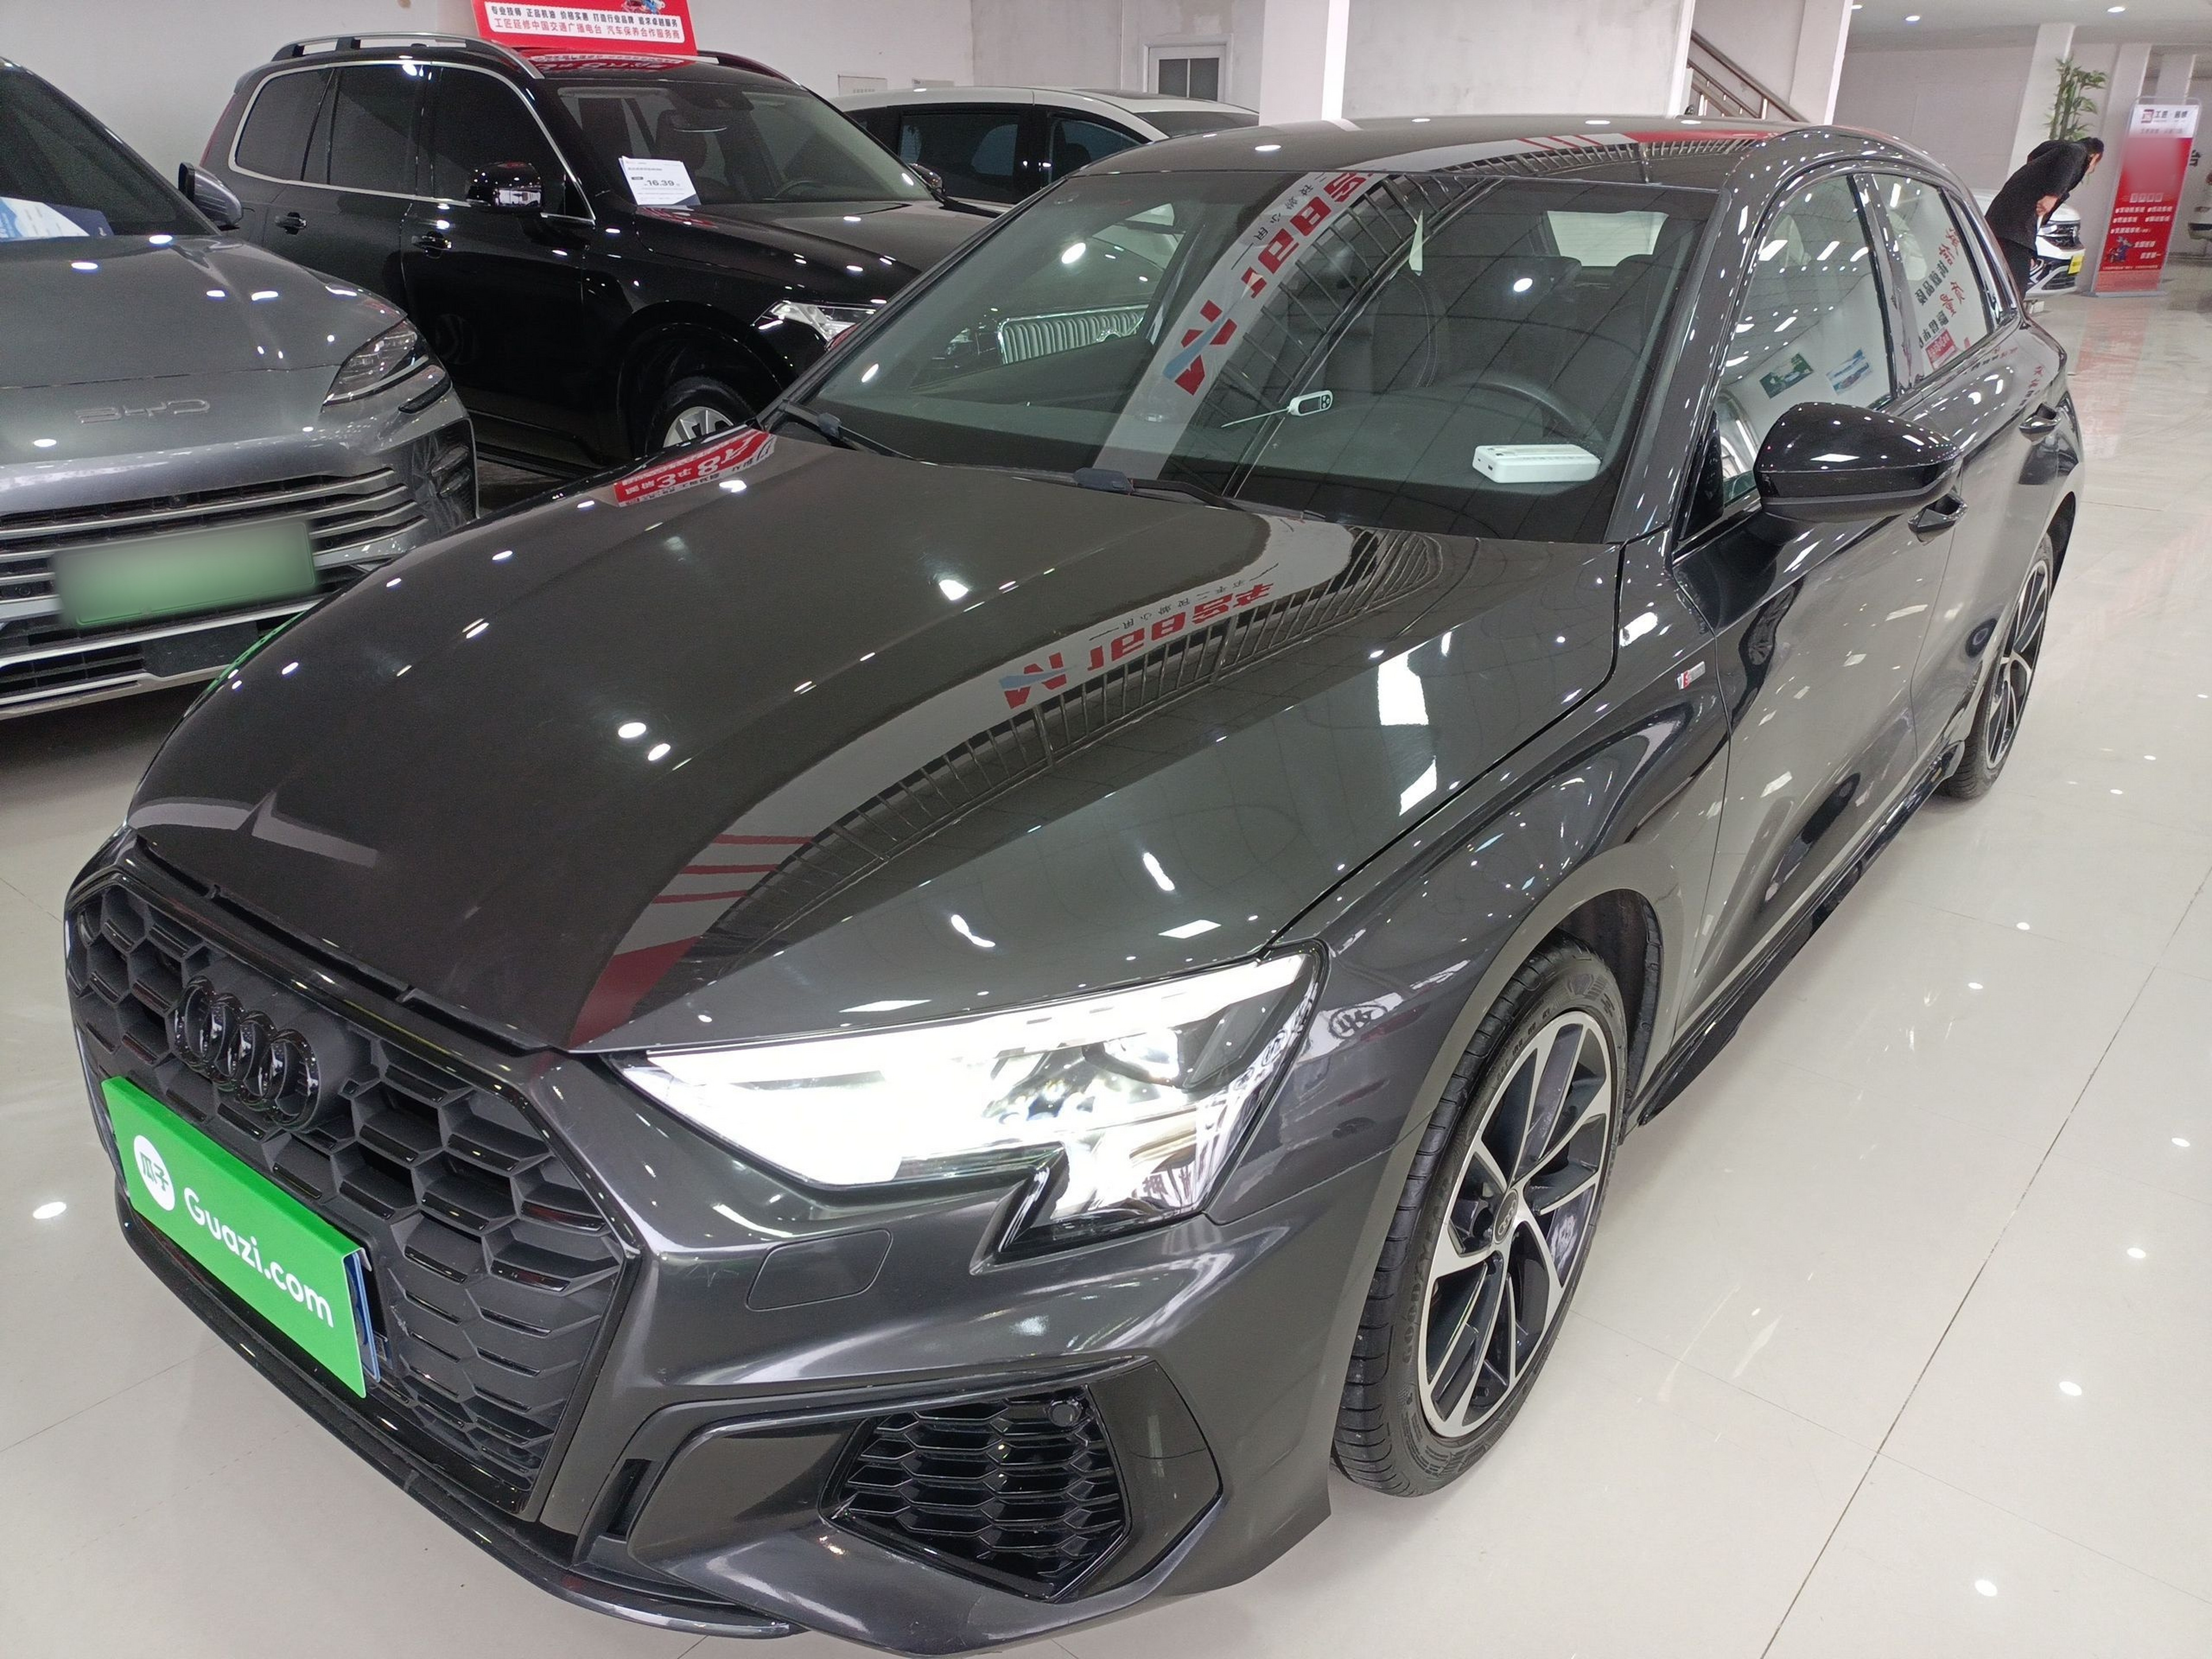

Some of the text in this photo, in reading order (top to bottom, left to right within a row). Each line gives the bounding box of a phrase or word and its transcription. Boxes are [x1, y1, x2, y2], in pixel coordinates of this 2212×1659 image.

[491, 6, 679, 28] 专业技师 正品机油 价格实惠 打造行业品牌 追求卓越服务
[494, 17, 680, 40] 工匠延修中国交通广播电台 汽车保养合作服务商
[75, 399, 210, 423] BYD
[139, 1151, 170, 1192] 瓜子
[183, 1187, 334, 1328] Guazi.com
